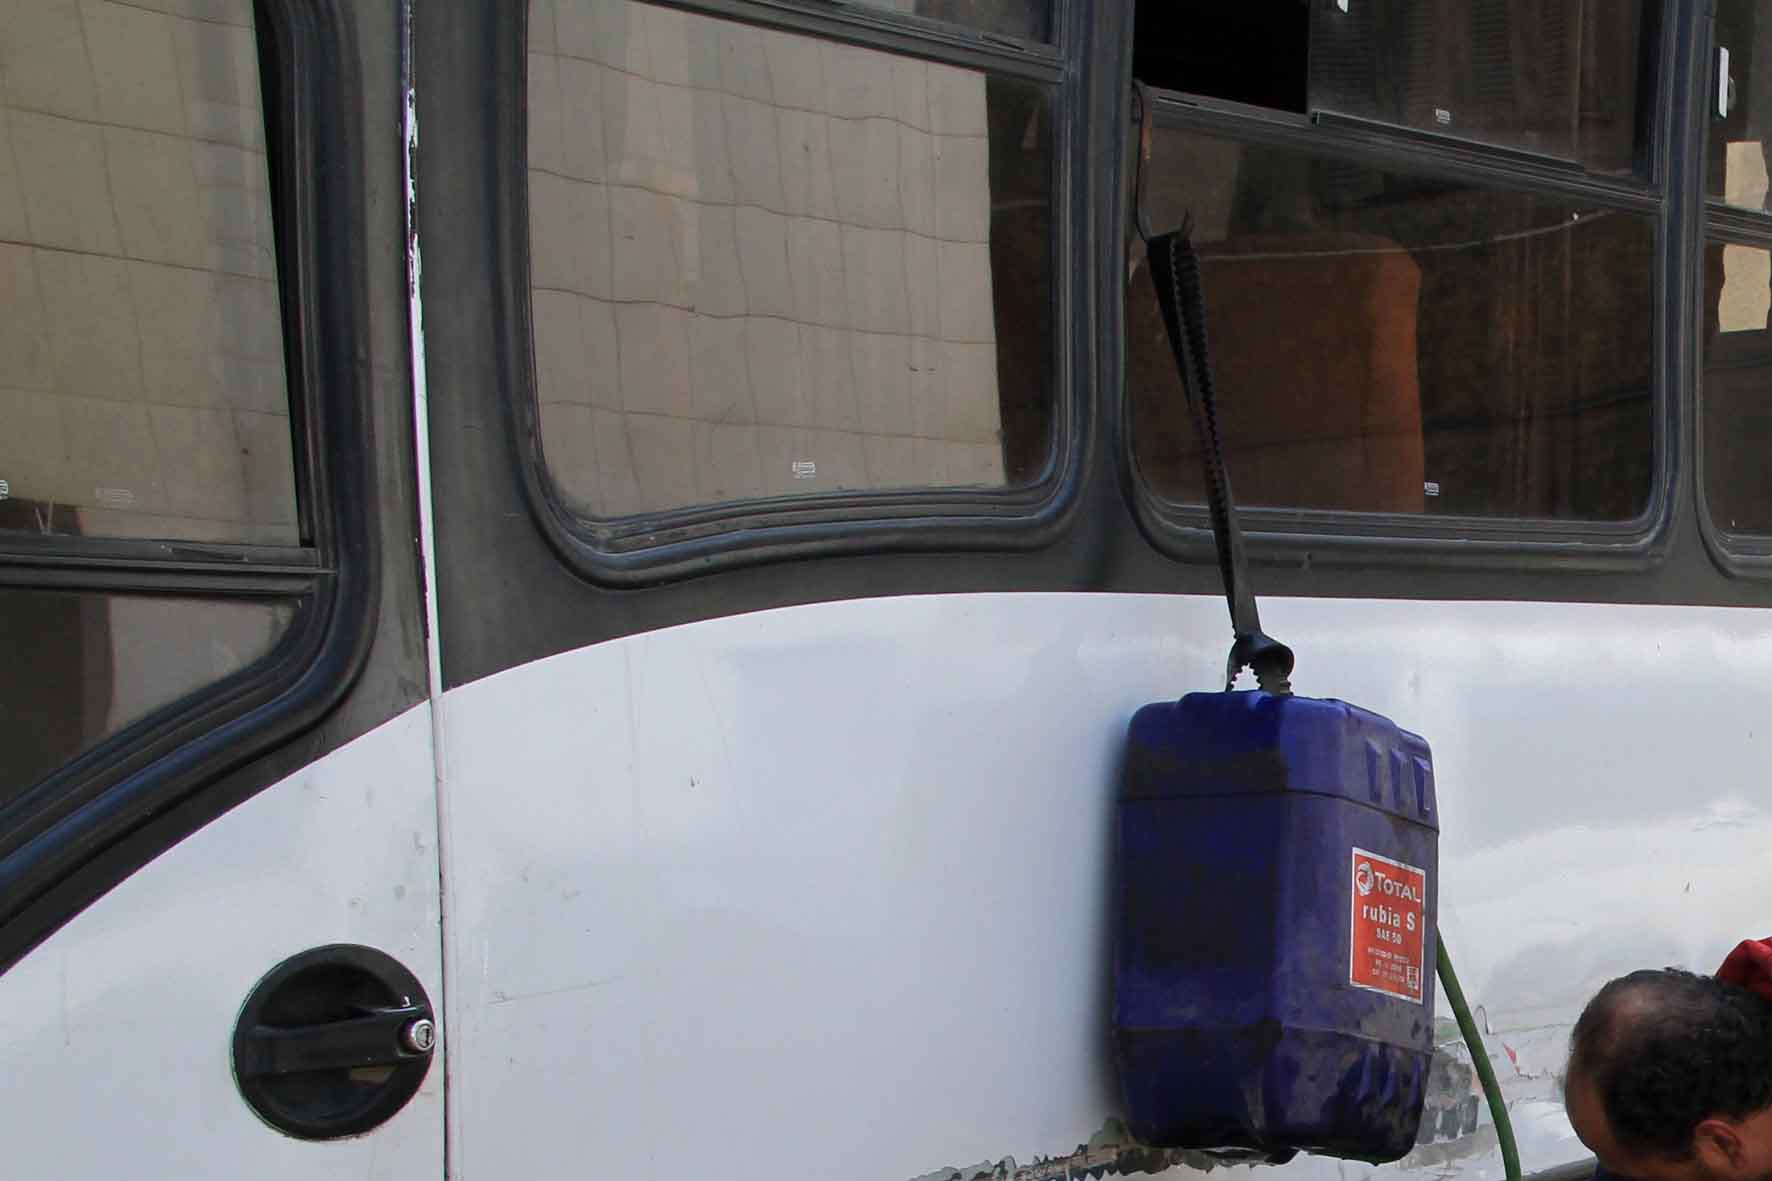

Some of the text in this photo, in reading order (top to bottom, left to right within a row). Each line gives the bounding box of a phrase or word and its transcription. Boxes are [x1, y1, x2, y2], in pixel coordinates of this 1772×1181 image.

[1375, 870, 1421, 902] TOTAL
[1363, 903, 1416, 931] rubia S
[1376, 927, 1390, 942] SAE
